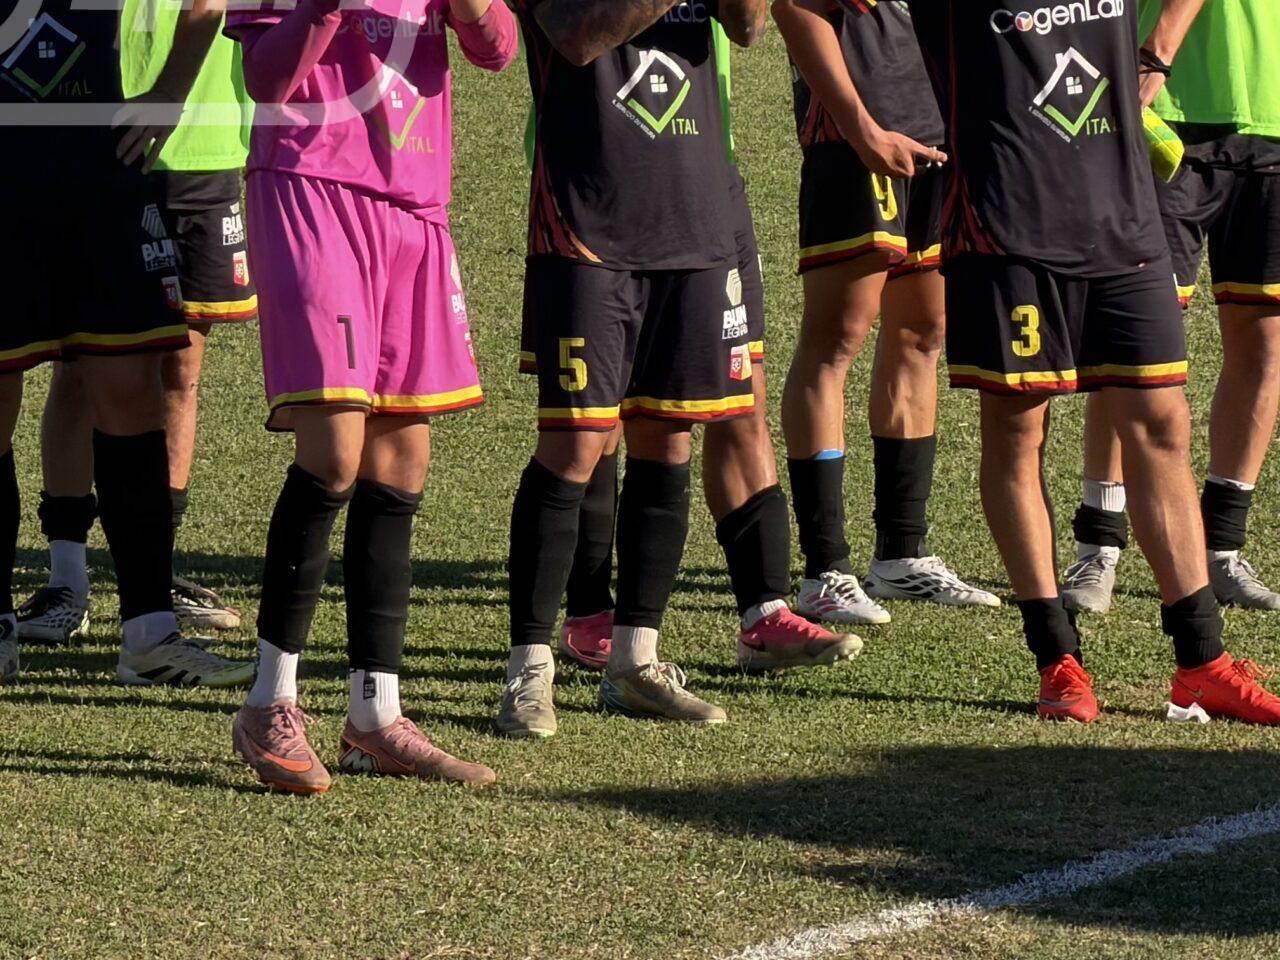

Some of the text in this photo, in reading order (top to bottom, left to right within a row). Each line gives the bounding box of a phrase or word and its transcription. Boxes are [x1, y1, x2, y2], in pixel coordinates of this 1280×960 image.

[336, 314, 356, 369] 1
[1011, 304, 1040, 357] 3
[558, 337, 589, 392] 5
